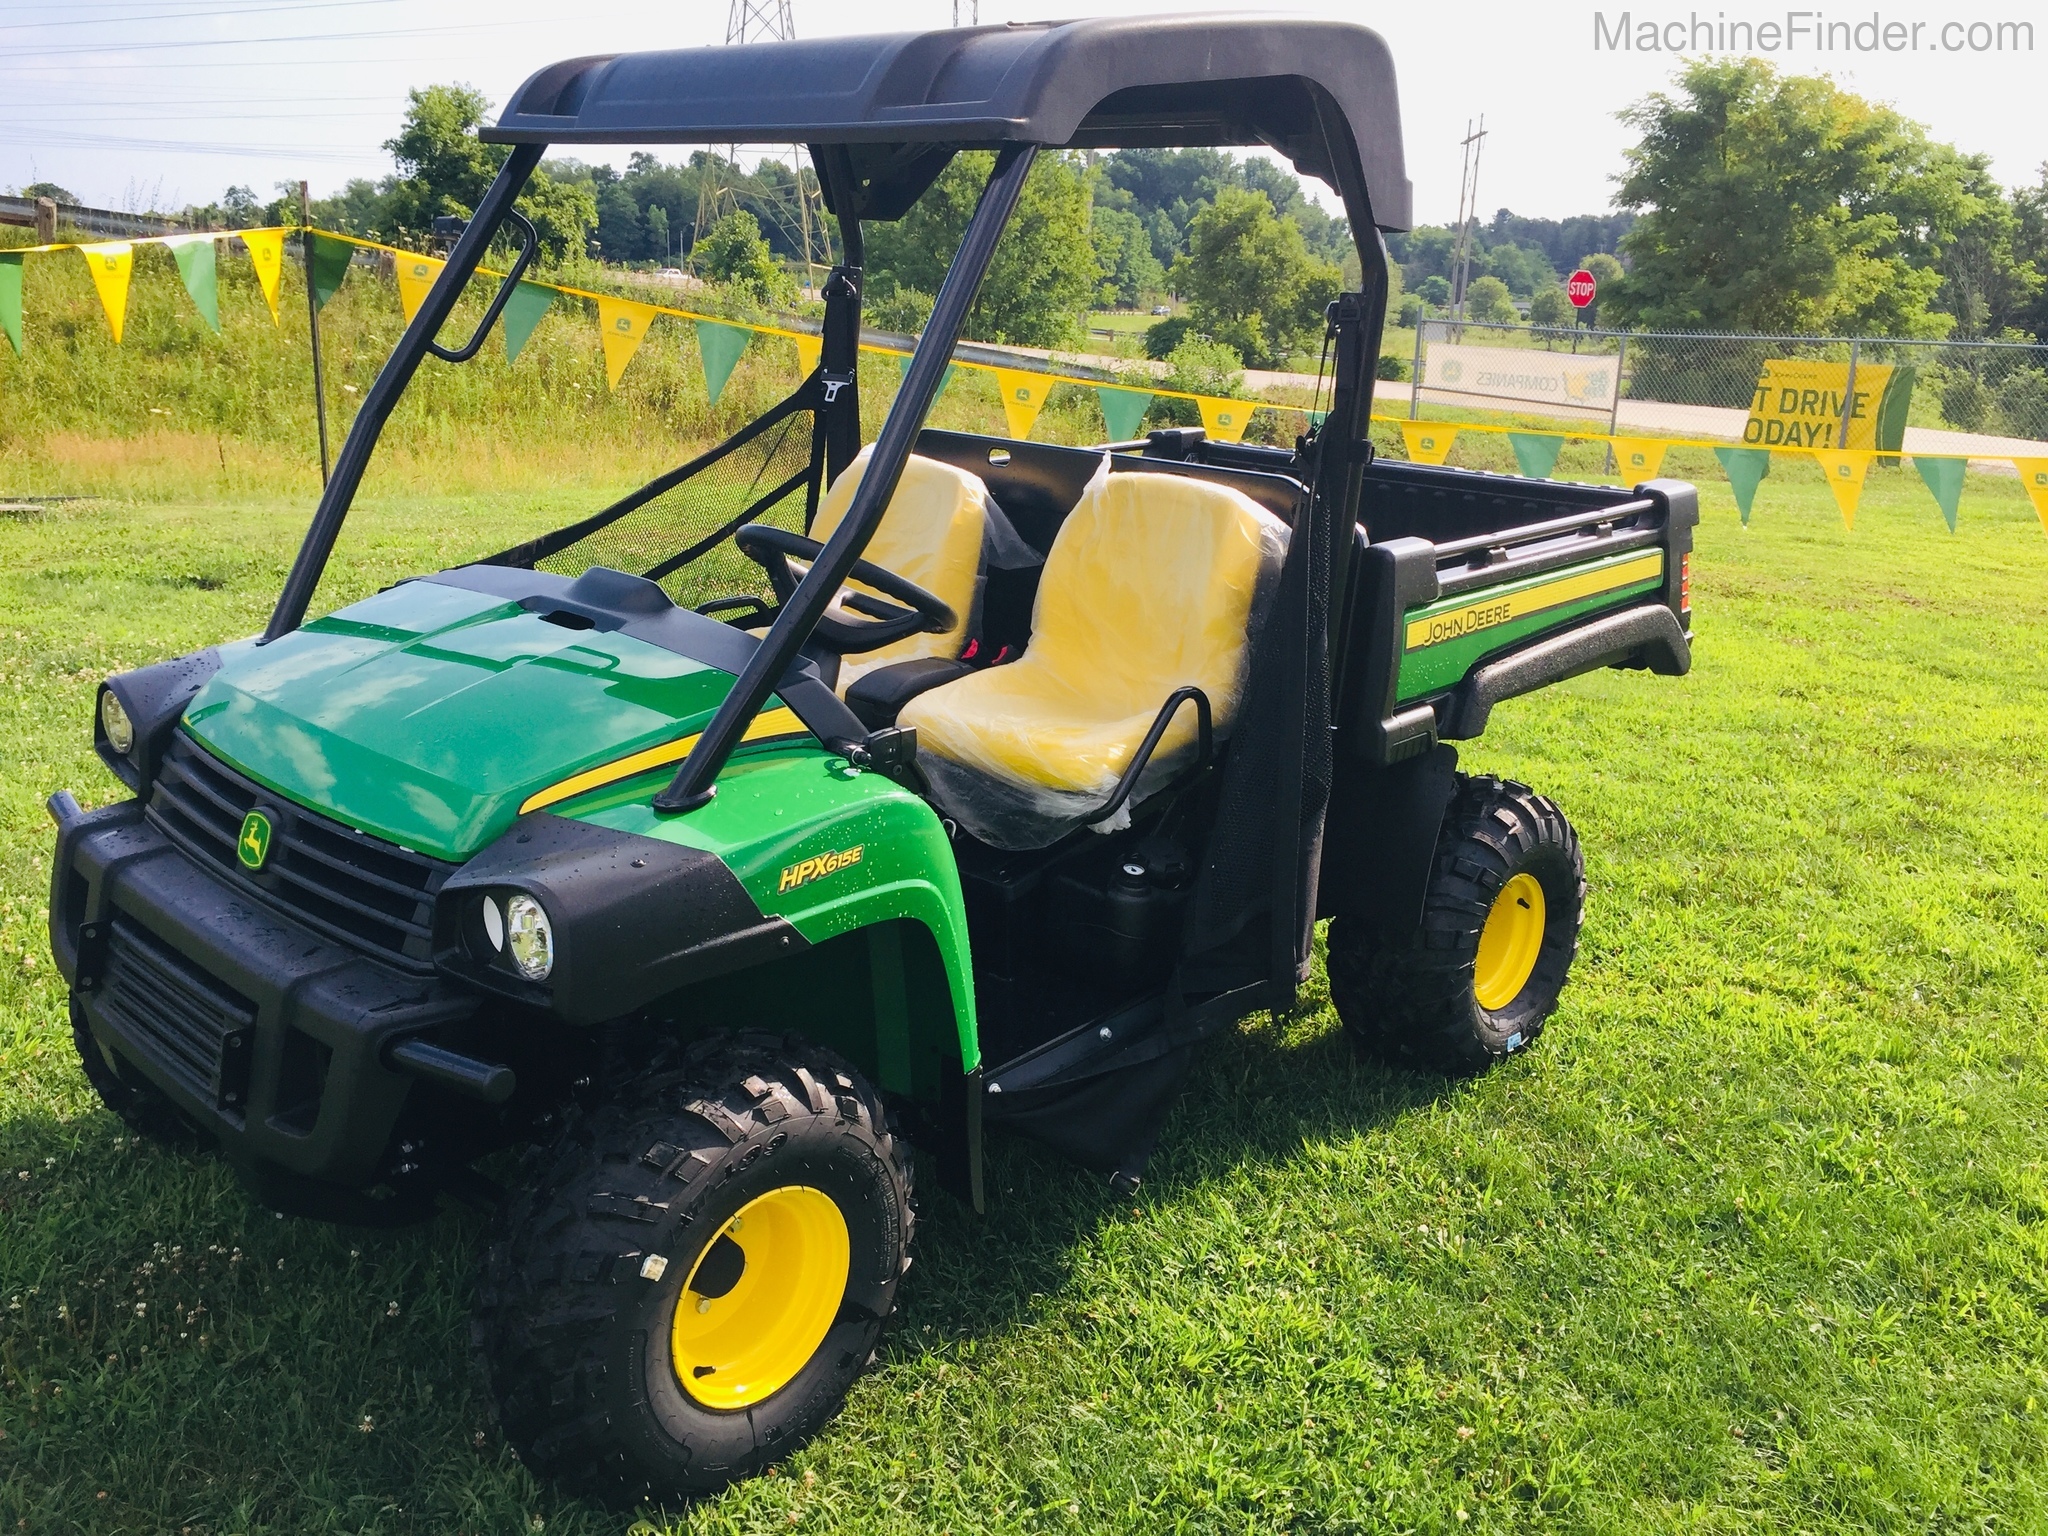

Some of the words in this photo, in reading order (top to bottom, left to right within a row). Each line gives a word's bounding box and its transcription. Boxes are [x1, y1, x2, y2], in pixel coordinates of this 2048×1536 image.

[1569, 281, 1594, 297] STOP
[1756, 386, 1772, 412] T
[1779, 388, 1870, 419] DRIVE
[1743, 418, 1833, 448] ODAY!
[1424, 617, 1463, 643] JOHN
[1466, 603, 1511, 630] DEERE
[779, 846, 863, 892] HPX615E
